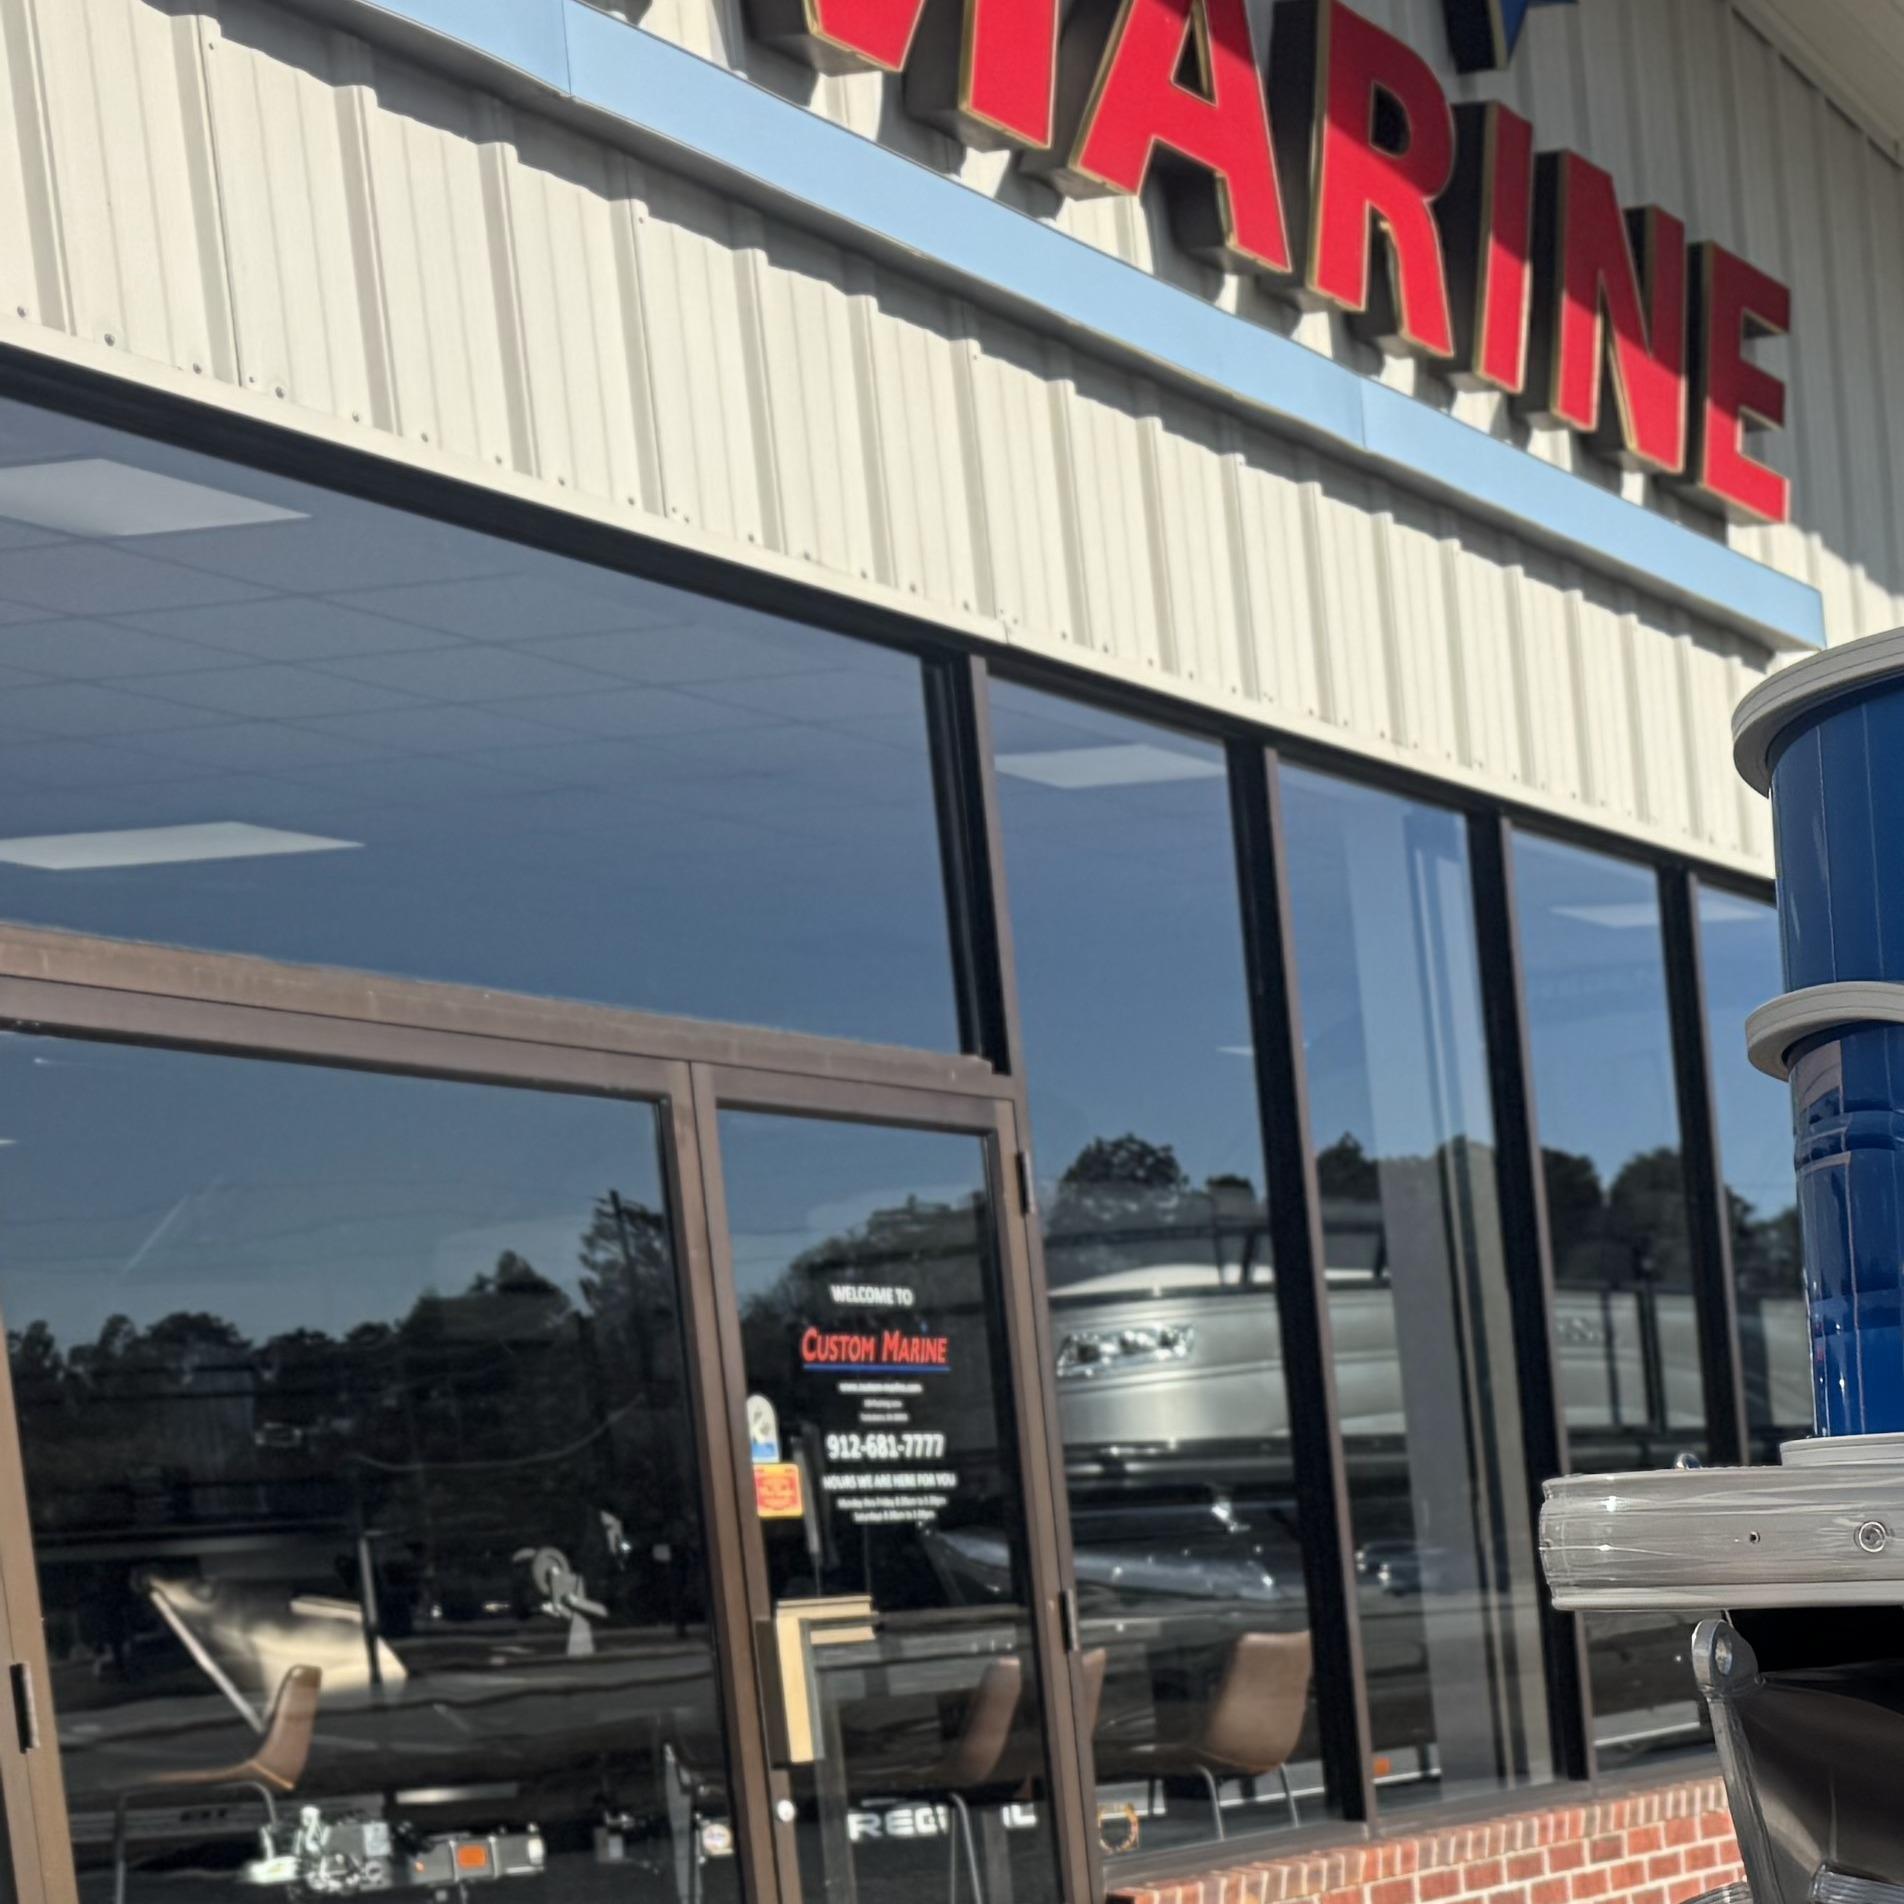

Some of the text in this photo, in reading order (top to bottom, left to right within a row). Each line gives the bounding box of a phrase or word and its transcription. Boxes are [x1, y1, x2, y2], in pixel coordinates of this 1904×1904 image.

[830, 1285, 914, 1306] WELCOME TO
[826, 1433, 945, 1459] 912-681-7777
